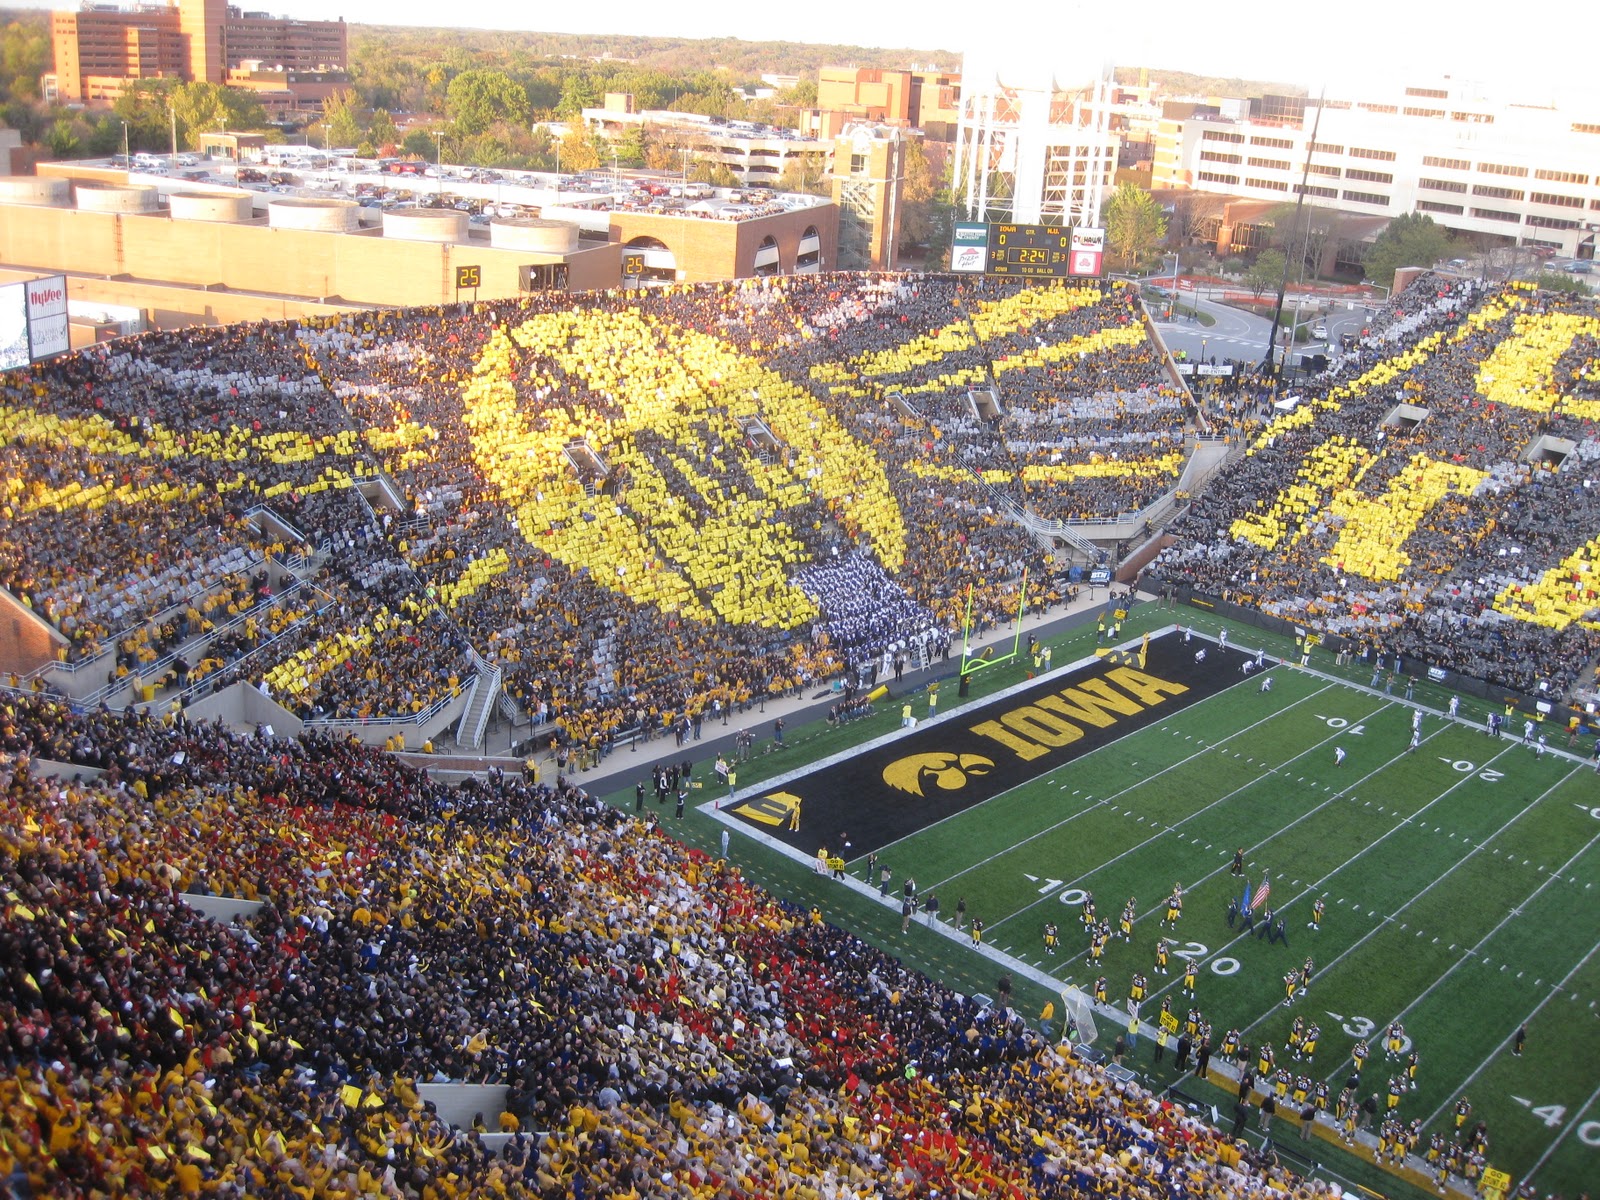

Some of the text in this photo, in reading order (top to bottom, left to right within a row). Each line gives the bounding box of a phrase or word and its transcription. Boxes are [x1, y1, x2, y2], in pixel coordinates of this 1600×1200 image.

[999, 234, 1006, 245] 0
[1060, 236, 1067, 248] 0
[627, 257, 643, 274] 25
[1019, 250, 1046, 263] 2:24
[460, 268, 479, 286] 25
[968, 666, 1190, 762] IOWA
[1036, 878, 1088, 905] 10
[1173, 942, 1241, 975] 20
[1342, 1016, 1412, 1054] 30
[1532, 1104, 1600, 1147] 40
